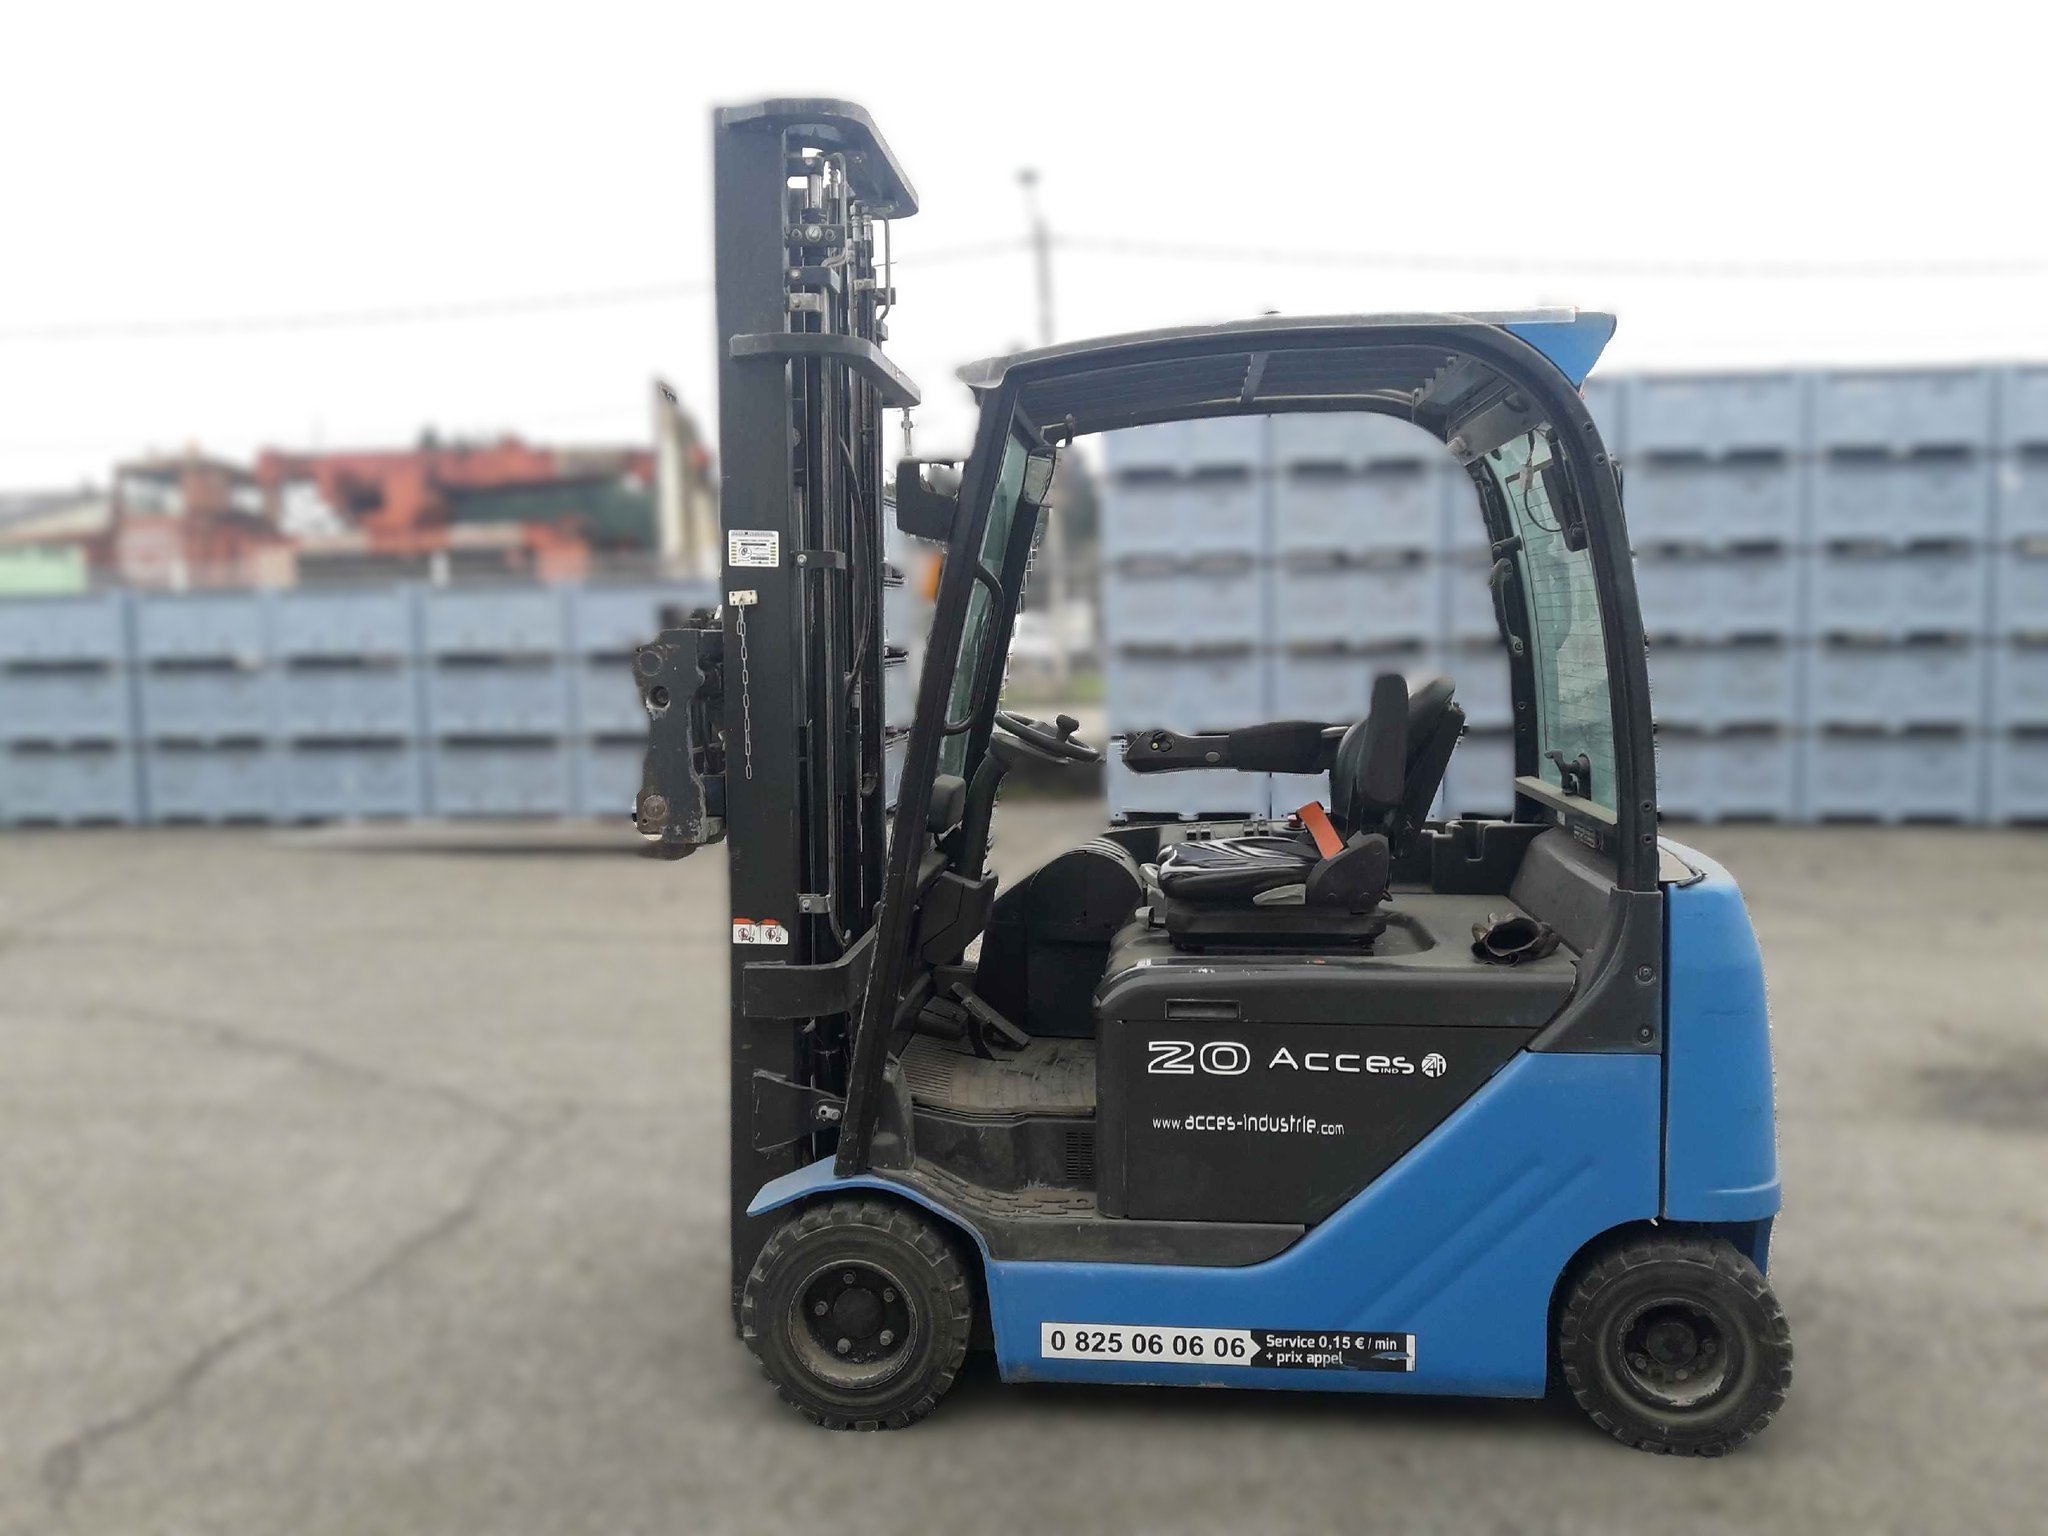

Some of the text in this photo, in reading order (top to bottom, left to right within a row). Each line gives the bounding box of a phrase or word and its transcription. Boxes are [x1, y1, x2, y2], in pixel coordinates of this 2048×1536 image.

[1147, 1040, 1251, 1076] 20
[1268, 1046, 1415, 1075] Acces
[1152, 1113, 1345, 1135] www.acces-industrie.com
[1051, 1330, 1246, 1358] 0 825 06 06 06
[1266, 1334, 1316, 1348] Service
[1318, 1335, 1351, 1350] 0,15
[1354, 1336, 1365, 1350] €
[1375, 1337, 1397, 1351] min
[1276, 1350, 1303, 1367] prix
[1306, 1350, 1344, 1368] appel
